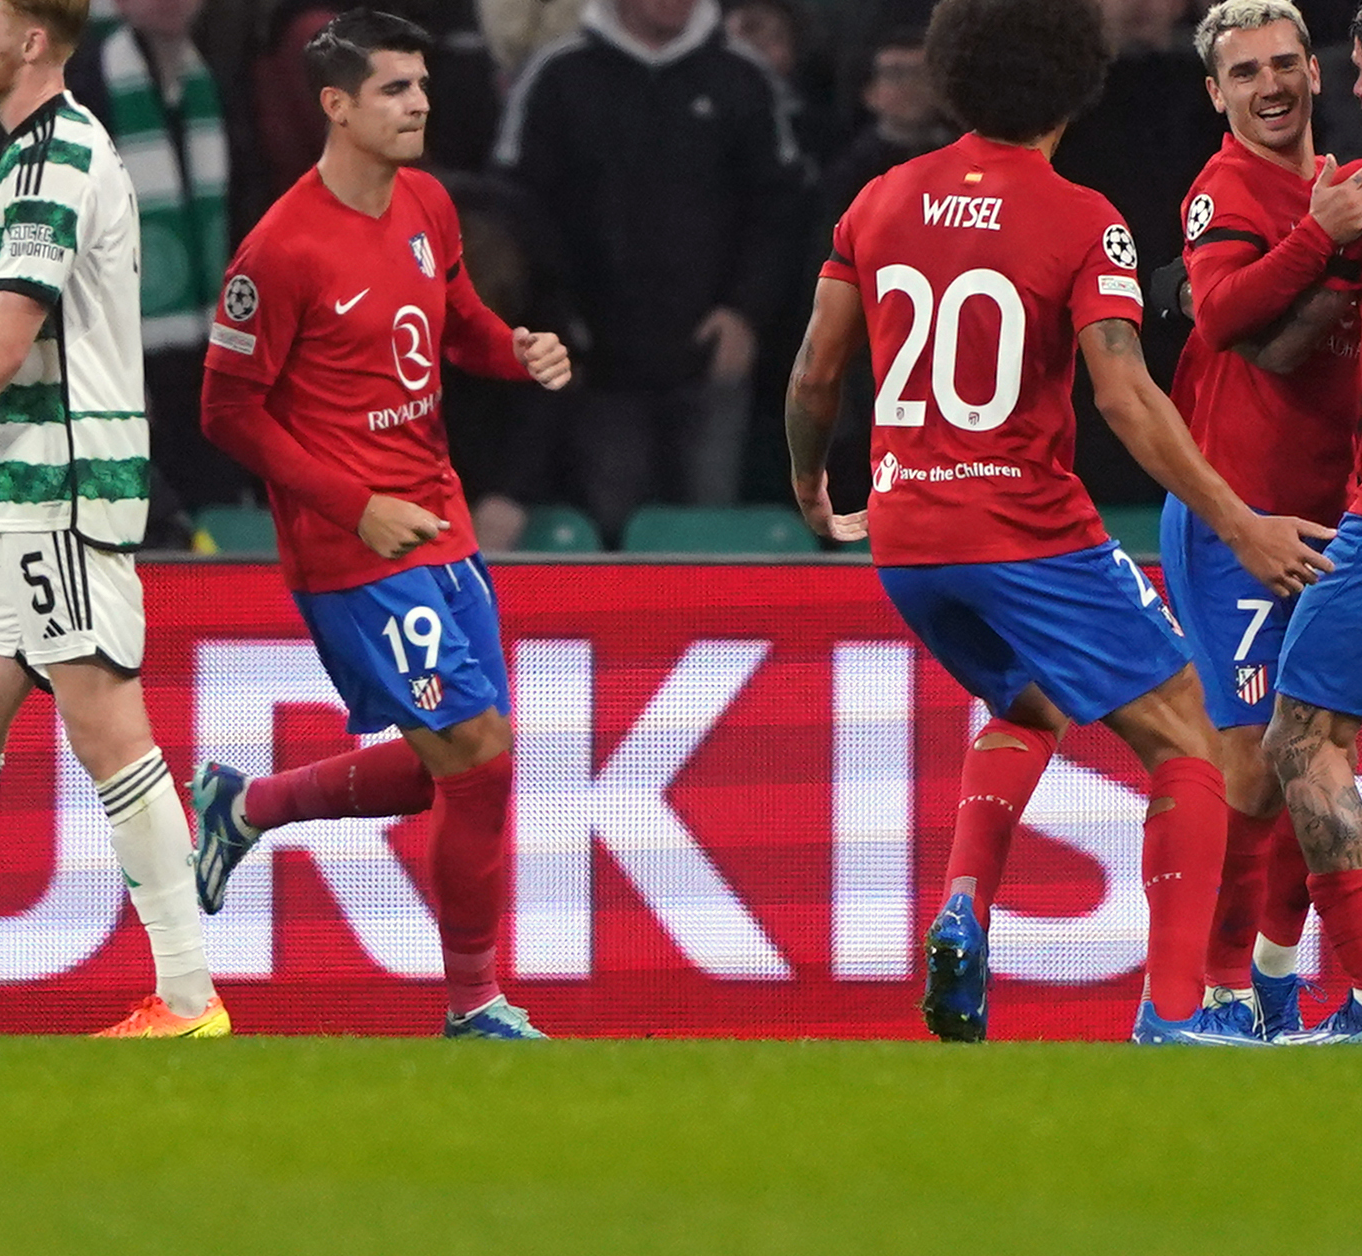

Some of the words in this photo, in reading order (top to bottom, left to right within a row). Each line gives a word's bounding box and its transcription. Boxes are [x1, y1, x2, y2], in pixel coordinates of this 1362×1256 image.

[923, 193, 1003, 230] WITSEL
[10, 242, 65, 263] OUDATION
[874, 263, 1026, 432] 20
[368, 394, 434, 431] RIYADH
[929, 465, 954, 482] the
[955, 462, 1022, 480] Children
[20, 551, 55, 615] 5
[382, 606, 442, 674] 19
[1233, 599, 1274, 661] 7
